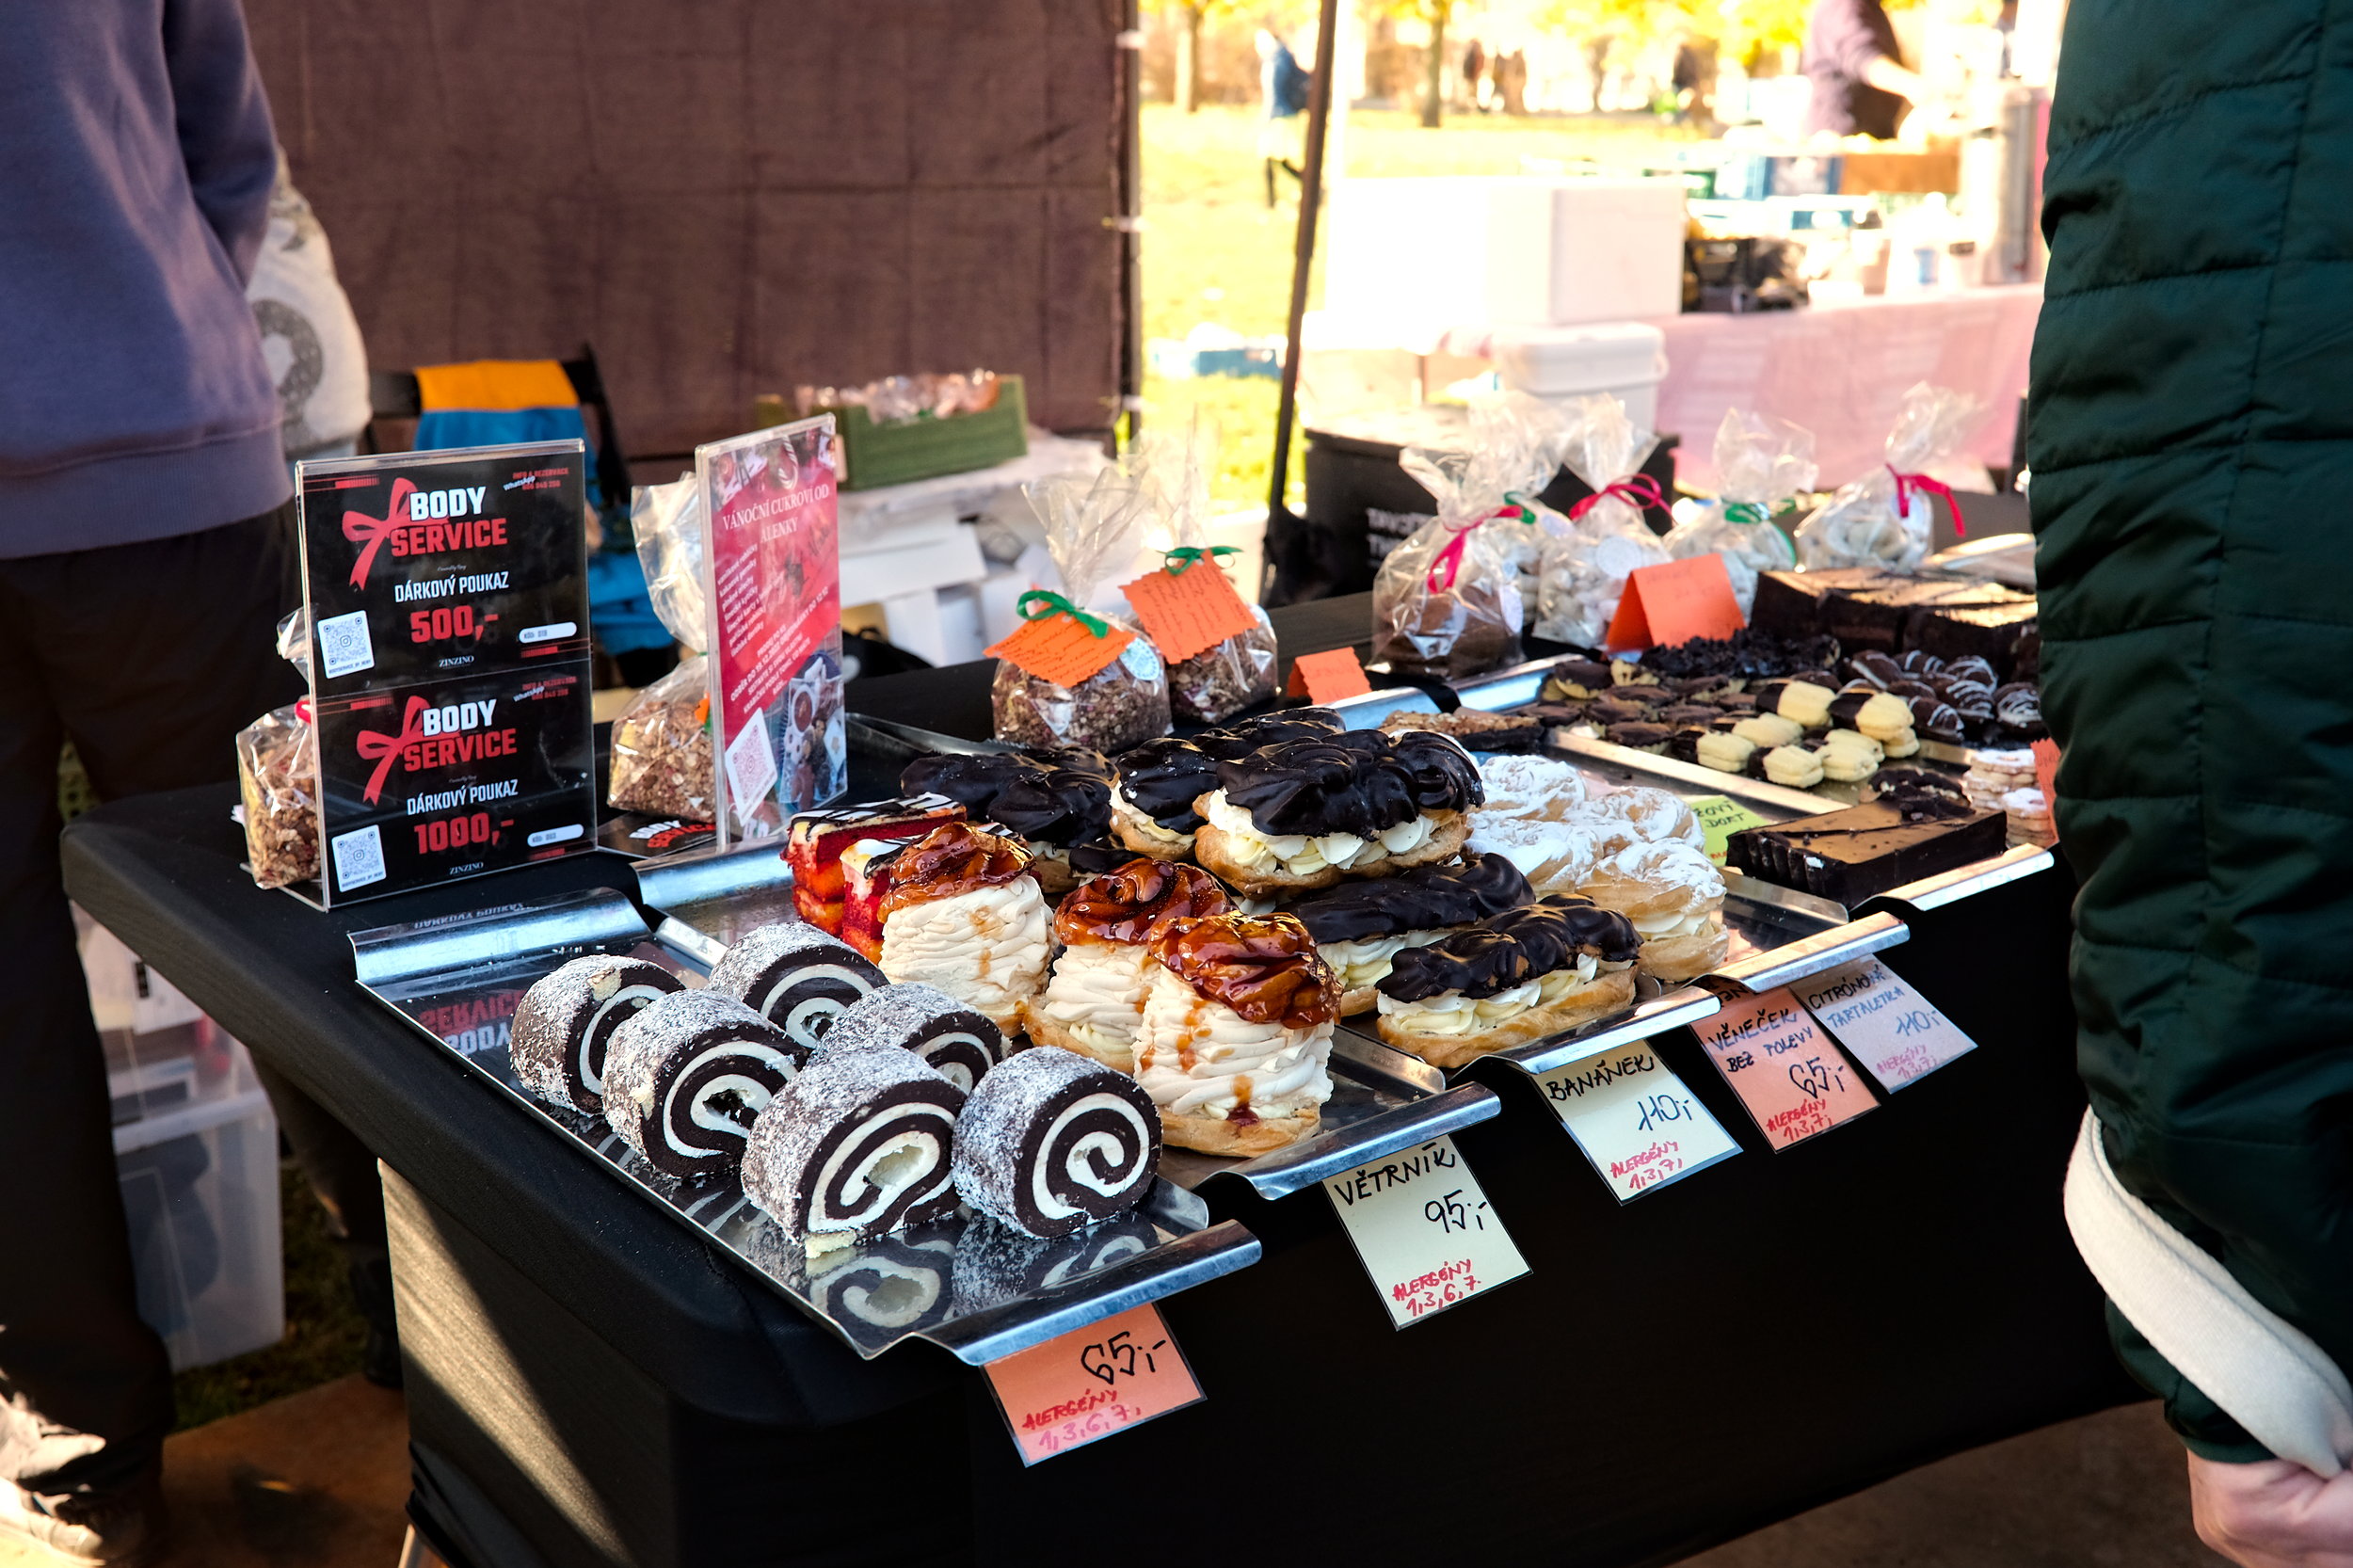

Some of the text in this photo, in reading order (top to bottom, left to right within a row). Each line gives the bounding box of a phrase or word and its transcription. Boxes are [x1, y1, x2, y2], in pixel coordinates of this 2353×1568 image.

[503, 475, 536, 491] WhatsApp
[409, 486, 487, 521] BODY
[722, 484, 829, 531] VÁNOČNÍ CUKROVÍ OD
[391, 518, 508, 557] SERVICE
[760, 517, 798, 543] ALENKY
[394, 571, 509, 603] DÁRKOVÝ POUKAZ
[409, 604, 499, 643] 500,-
[438, 655, 475, 668] ZINZINO
[513, 685, 546, 703] WhatsApp
[423, 698, 498, 736] BODY
[404, 728, 518, 772] SERVICE
[407, 778, 519, 816] DÁRKOVÝ POUKAZ
[413, 811, 515, 855] 1000,-
[449, 861, 485, 875] ZINZINO
[1827, 985, 1905, 1029] TARTALETKA
[1707, 1008, 1798, 1051] VĚNEČEK
[1727, 1027, 1813, 1073] BEZ POLEVY
[1545, 1053, 1655, 1101] BANÁNEK
[1766, 1098, 1827, 1132] ALERGÉNY
[1334, 1142, 1456, 1207] VĚTRNÍK
[1609, 1141, 1679, 1178] ALERGÉNY
[1392, 1258, 1472, 1302] ALERGÉNY
[1021, 1388, 1118, 1431] ALERGÉNY
